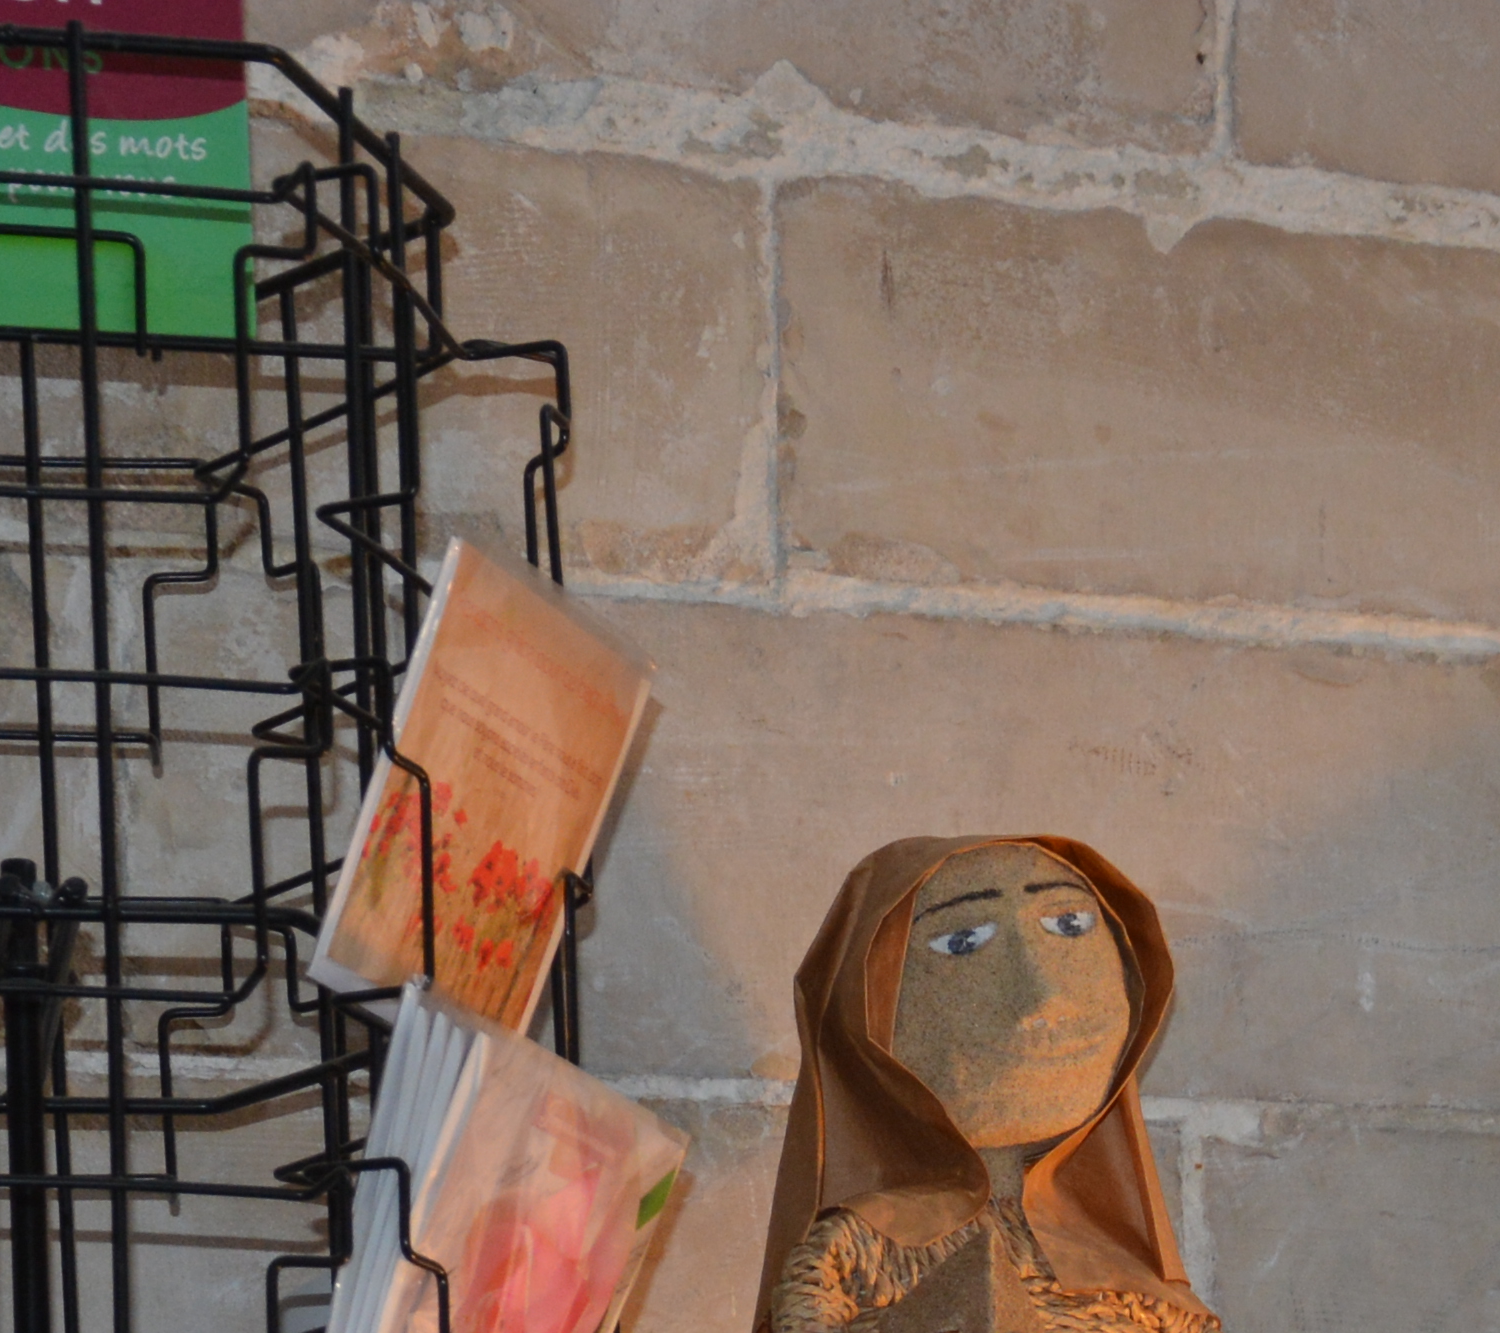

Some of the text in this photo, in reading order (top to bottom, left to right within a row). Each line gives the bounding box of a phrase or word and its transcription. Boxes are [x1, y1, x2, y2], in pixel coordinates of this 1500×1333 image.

[0, 121, 29, 150] et
[44, 117, 107, 155] ds
[120, 132, 208, 161] mots
